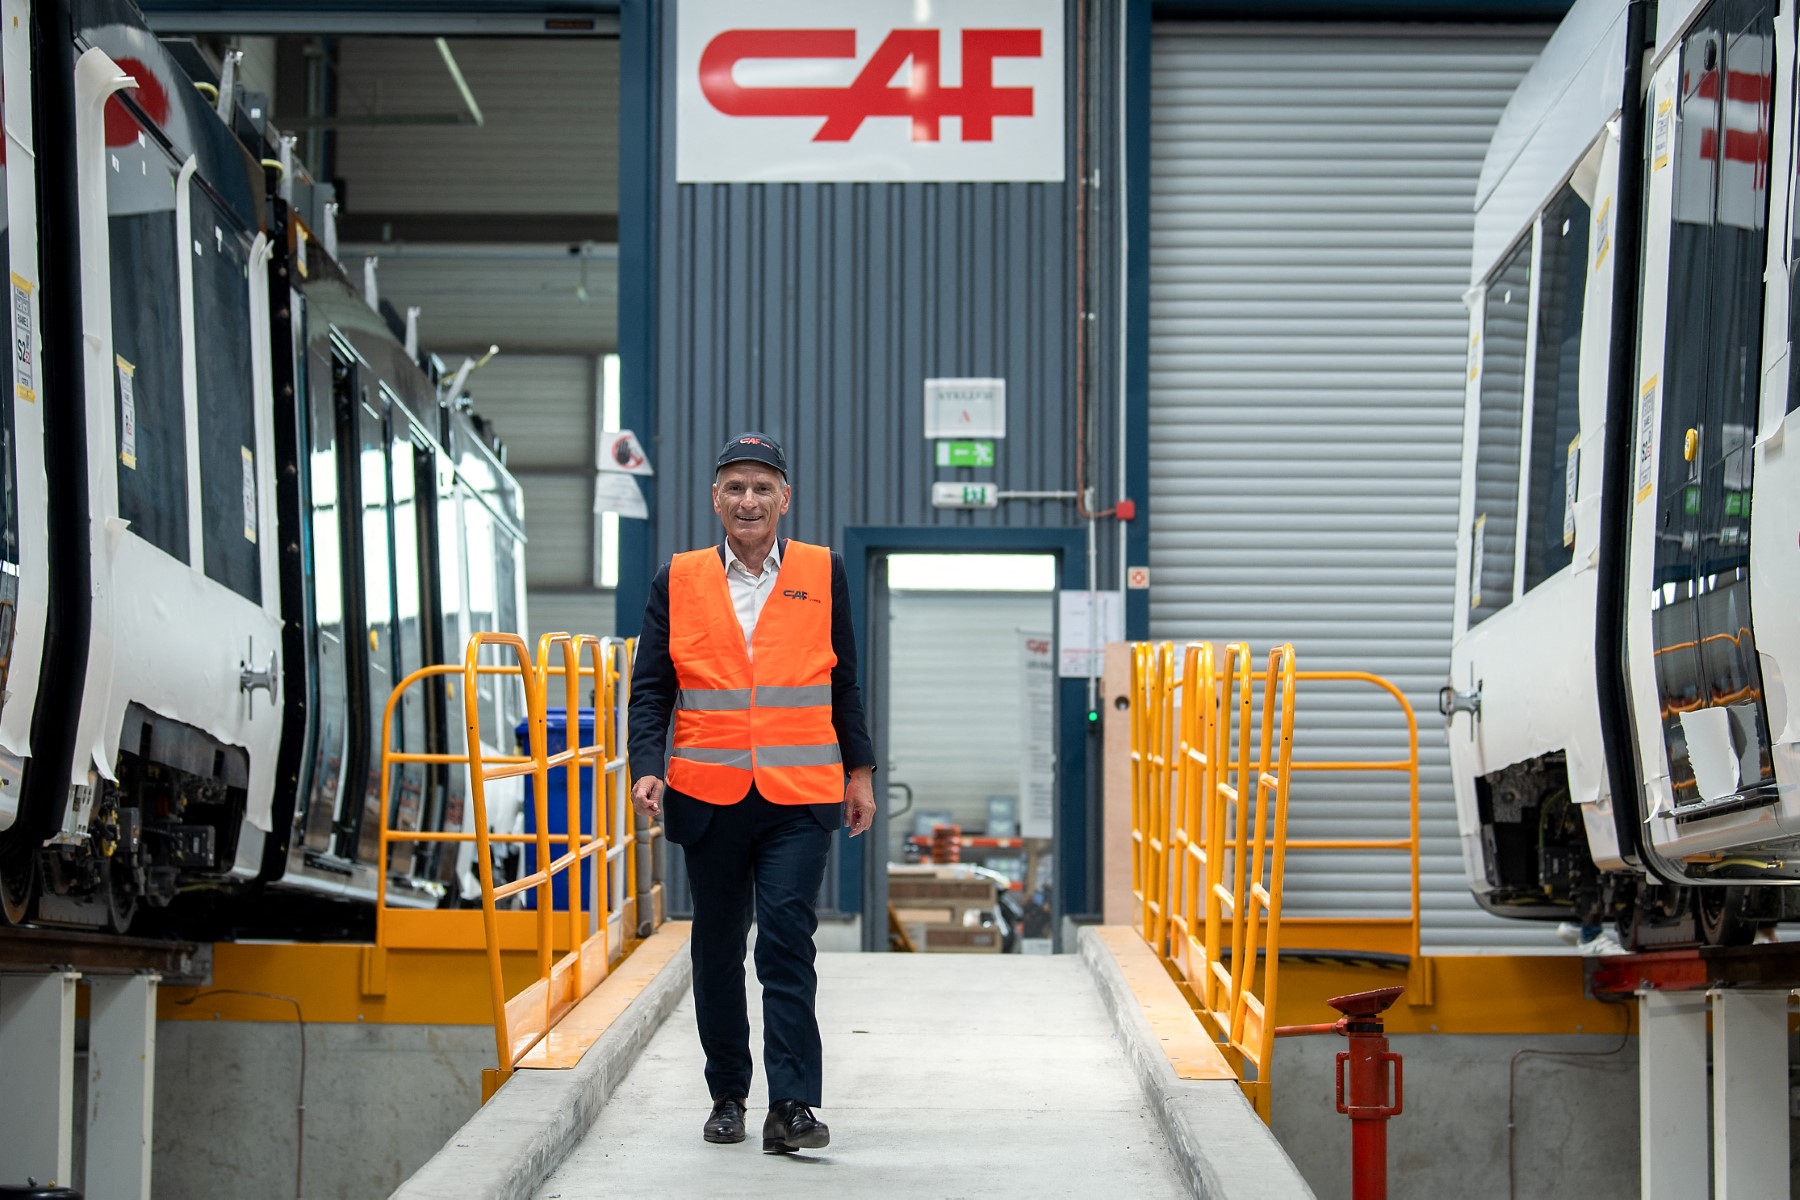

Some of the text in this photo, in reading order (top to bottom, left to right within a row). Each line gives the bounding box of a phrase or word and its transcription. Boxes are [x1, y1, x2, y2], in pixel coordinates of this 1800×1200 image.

[698, 29, 1042, 142] CAF
[740, 437, 761, 445] CAF
[783, 589, 808, 600] CAF
